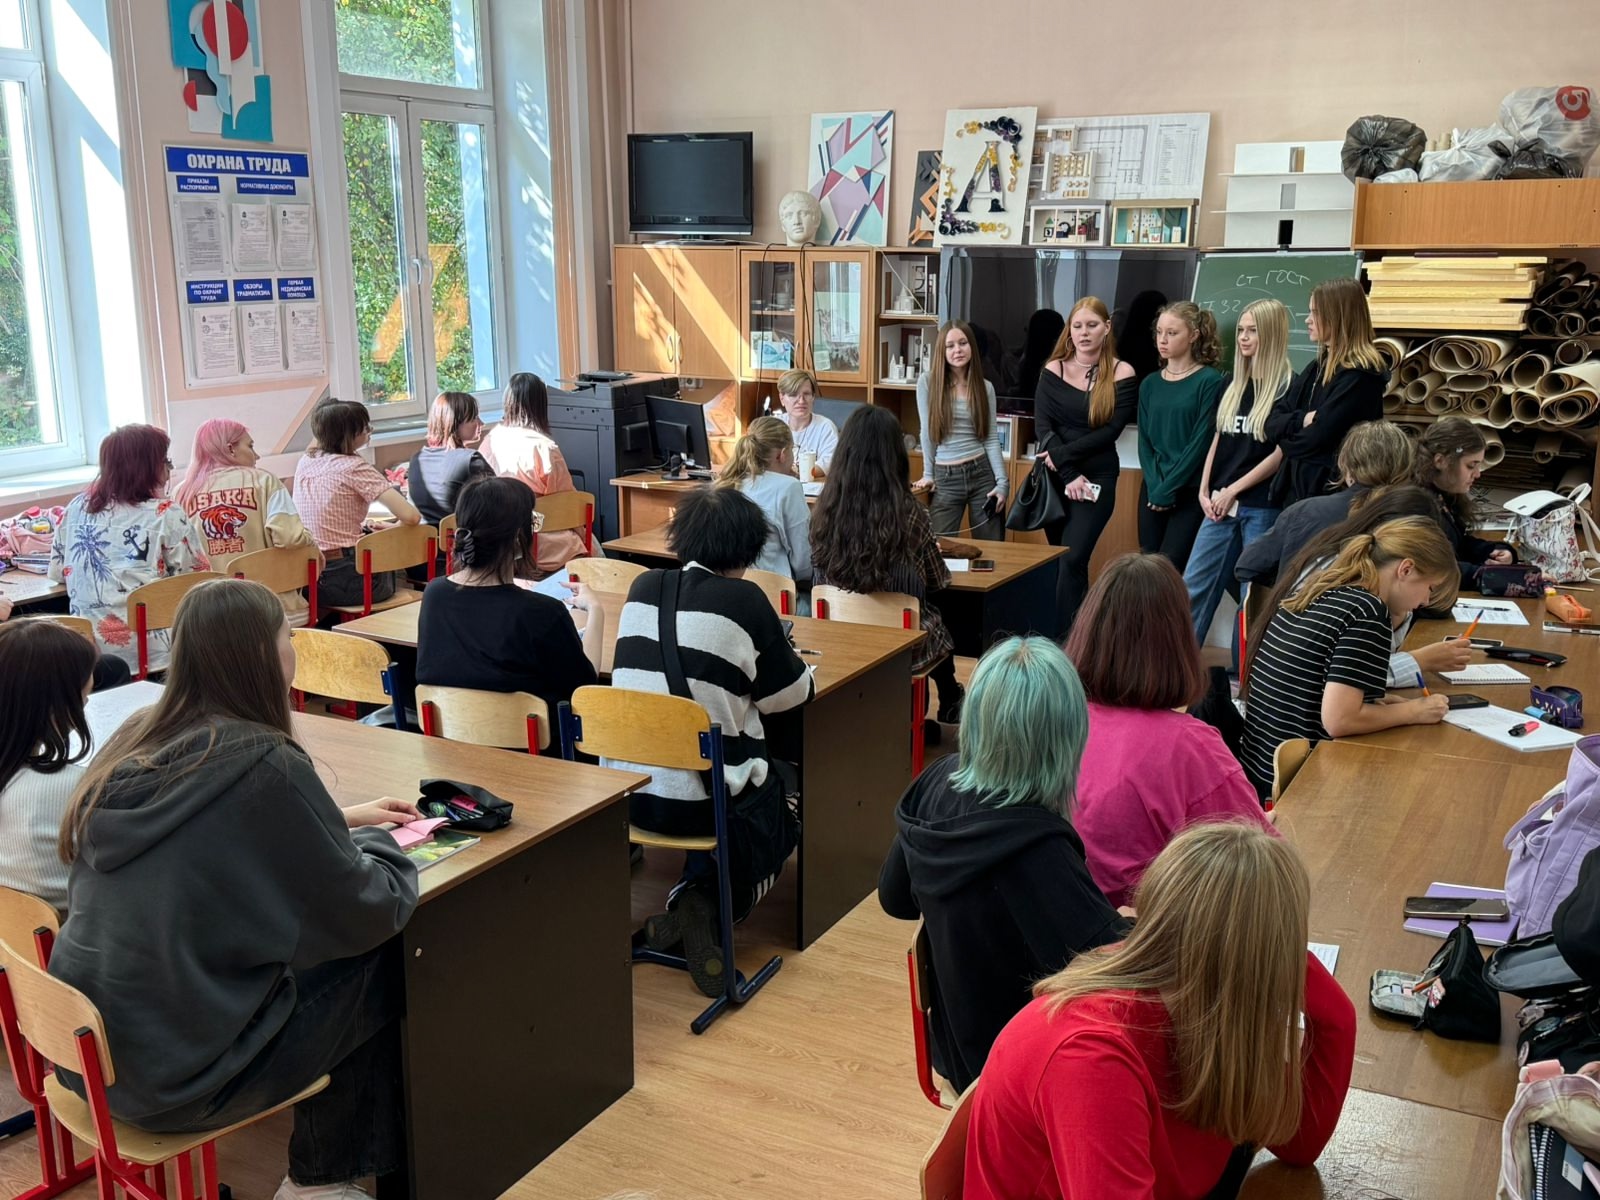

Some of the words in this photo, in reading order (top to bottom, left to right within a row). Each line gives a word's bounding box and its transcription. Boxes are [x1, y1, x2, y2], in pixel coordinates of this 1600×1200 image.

[186, 153, 246, 171] ОХРАНА
[246, 157, 292, 174] ТРУДА
[239, 182, 270, 190] НОРМАТИВНЫЕ
[269, 183, 294, 191] ДОКУМЕНТЫ
